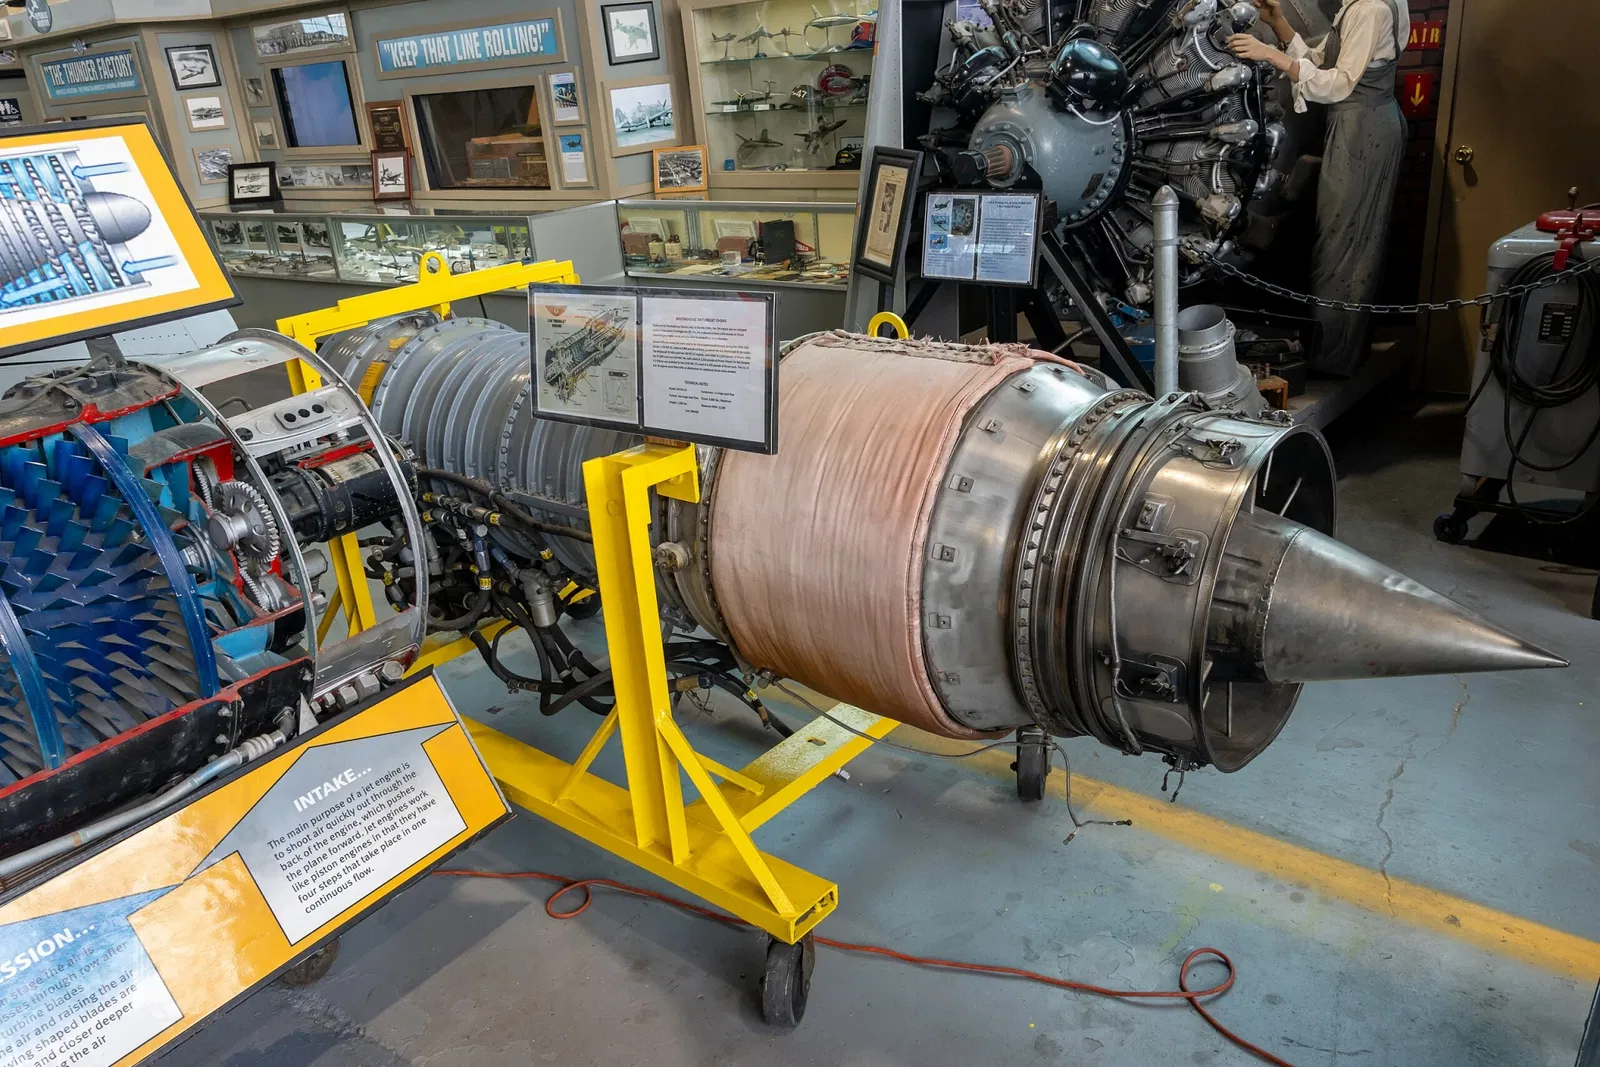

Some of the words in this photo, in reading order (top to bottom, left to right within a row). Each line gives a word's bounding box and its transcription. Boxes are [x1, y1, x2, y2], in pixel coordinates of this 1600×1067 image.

[384, 40, 418, 68] "KEEP
[420, 35, 451, 64] THAT
[454, 32, 482, 61] LINE
[482, 22, 549, 58] ROLLING!"
[1410, 28, 1440, 44] AIR
[44, 64, 65, 86] "THE
[62, 59, 98, 84] THUNDER
[96, 53, 134, 80] FACTORY"
[267, 836, 286, 850] The
[286, 823, 310, 840] main
[310, 801, 346, 826] purpose
[346, 792, 356, 804] of
[361, 783, 373, 796] jet
[374, 768, 402, 788] engine
[402, 761, 410, 771] is
[274, 850, 284, 861] to
[286, 834, 312, 854] shoot
[312, 826, 324, 838] air
[326, 808, 356, 830] quickly
[356, 799, 370, 812] out
[370, 780, 402, 804] through
[402, 770, 416, 782] the
[294, 768, 372, 812] INTAKE...
[280, 856, 303, 872] back
[304, 847, 313, 858] of
[313, 838, 328, 850] the
[330, 820, 362, 842] engine,
[361, 803, 386, 821] which
[387, 786, 416, 808] pushes
[286, 870, 302, 882] the
[303, 854, 328, 872] plane
[328, 833, 364, 856] forward.
[364, 823, 377, 835] Jet
[377, 803, 408, 825] engines
[409, 789, 429, 804] work
[292, 878, 310, 893] like
[310, 860, 338, 883] piston
[340, 840, 372, 864] engines
[372, 832, 382, 842] in
[381, 822, 400, 836] that
[400, 811, 418, 826] they
[416, 798, 437, 814] have
[298, 888, 318, 904] four
[318, 870, 342, 892] steps
[342, 861, 362, 875] that
[361, 850, 380, 864] take
[380, 836, 402, 852] place
[402, 828, 412, 838] in
[412, 818, 427, 830] one
[304, 880, 353, 914] continuous
[354, 868, 375, 883] flow.
[0, 925, 95, 984] SSION...
[11, 977, 44, 1001] stage
[44, 964, 64, 980] the
[67, 955, 82, 967] air
[82, 946, 95, 956] is
[30, 972, 77, 1004] through
[79, 959, 100, 976] row
[102, 941, 128, 962] after
[0, 1010, 44, 1040] turbine
[44, 984, 85, 1012] blades
[15, 1033, 31, 1048] air
[34, 1016, 57, 1037] and
[58, 992, 98, 1020] raising
[98, 981, 118, 996] the
[120, 969, 134, 983] air
[34, 1052, 57, 1067] and
[59, 1027, 93, 1054] closer
[95, 1000, 134, 1031] deeper
[36, 1020, 79, 1052] shaped
[80, 996, 118, 1023] blades
[120, 983, 138, 999] are
[69, 1047, 90, 1063] the
[92, 1034, 107, 1050] air
